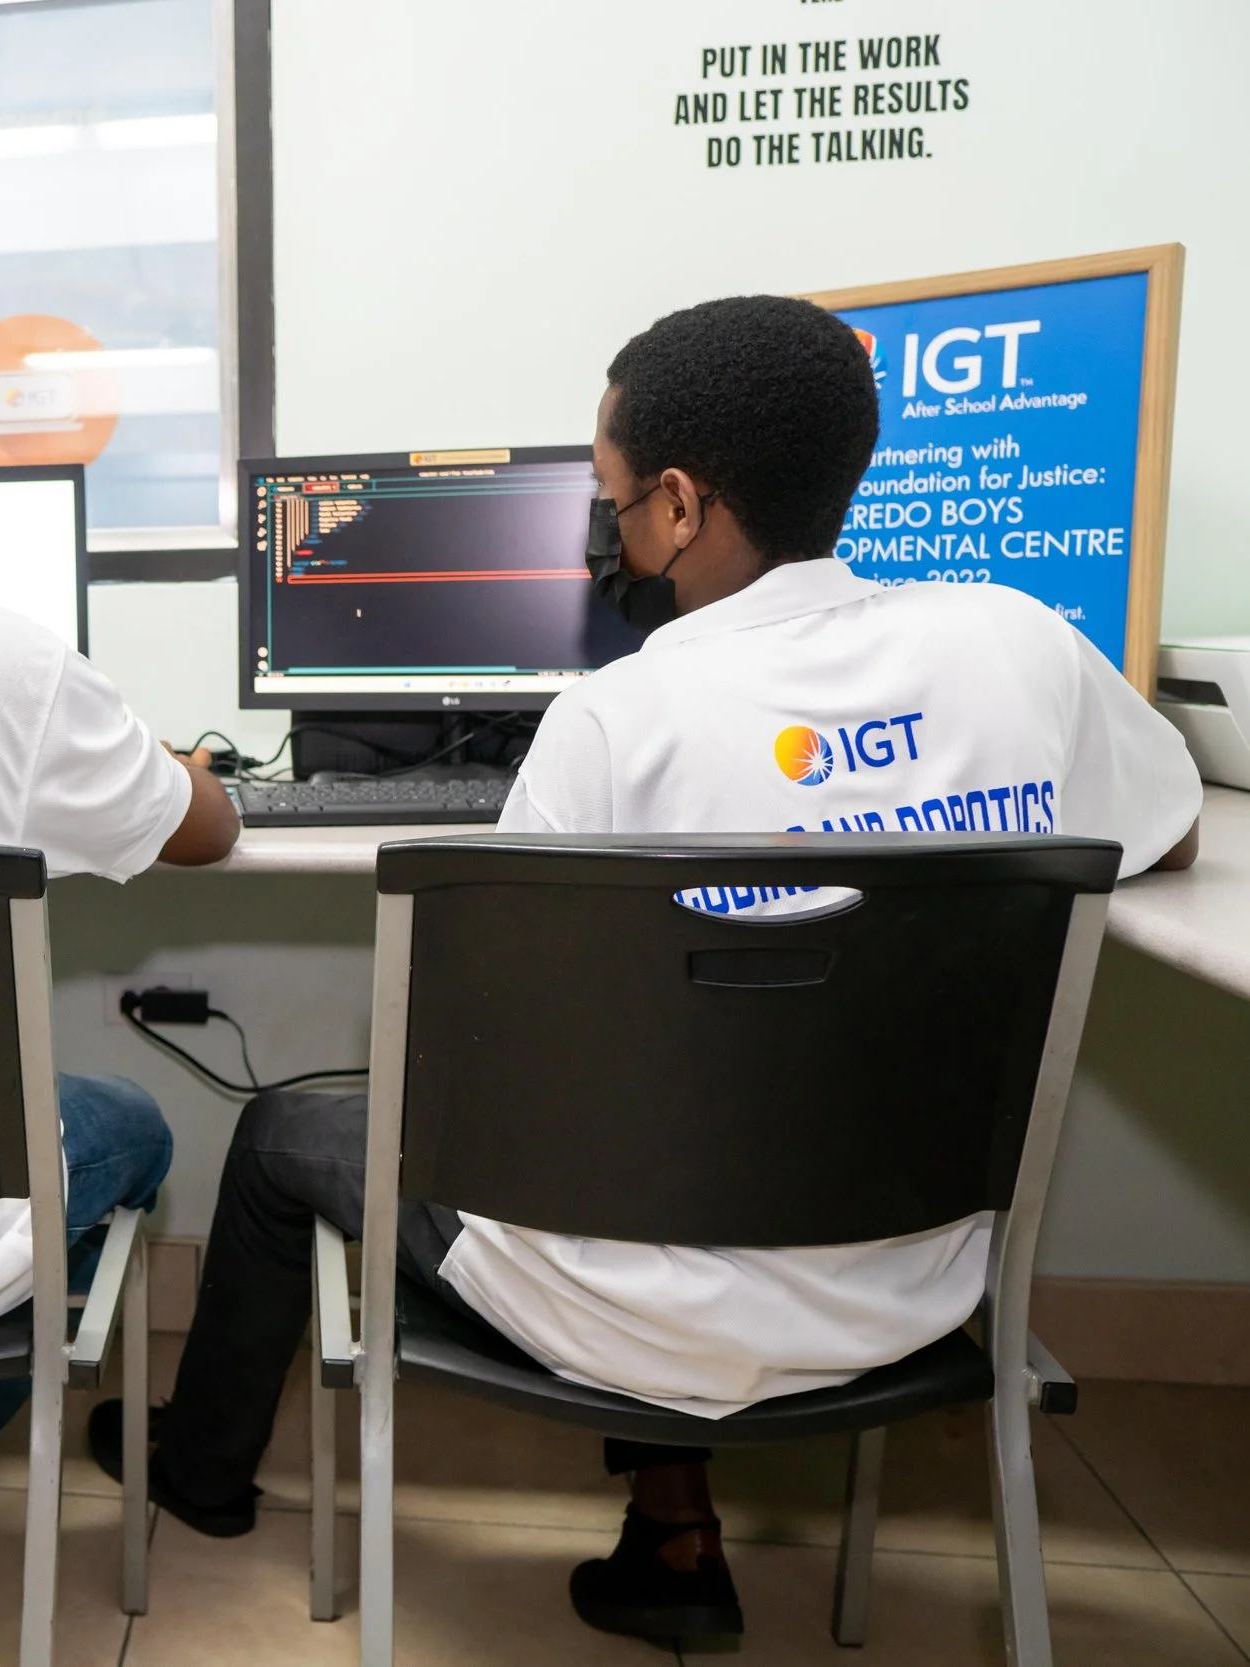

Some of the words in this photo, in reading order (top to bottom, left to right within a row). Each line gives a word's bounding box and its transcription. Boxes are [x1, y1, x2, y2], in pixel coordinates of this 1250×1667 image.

[702, 46, 751, 79] PUT
[761, 44, 787, 75] IN
[798, 40, 847, 73] THE
[858, 34, 941, 71] WORK
[674, 92, 727, 125] AND
[739, 89, 784, 122] LET
[794, 85, 842, 119] THE
[853, 78, 970, 116] RESULTS
[707, 136, 741, 168] DO
[753, 133, 800, 166] THE
[811, 127, 933, 163] TALKING.
[902, 320, 1041, 397] IGT
[902, 401, 942, 420] After
[944, 395, 997, 416] School
[999, 391, 1087, 412] Advantage
[971, 434, 1020, 460] with
[858, 470, 970, 497] oundation
[979, 465, 1009, 490] for
[1018, 463, 1105, 491] Justice:
[942, 497, 1024, 527] BOYS
[832, 532, 991, 564] OPMENTAL
[1000, 527, 1124, 558] CENTRE
[837, 712, 923, 773] IGT
